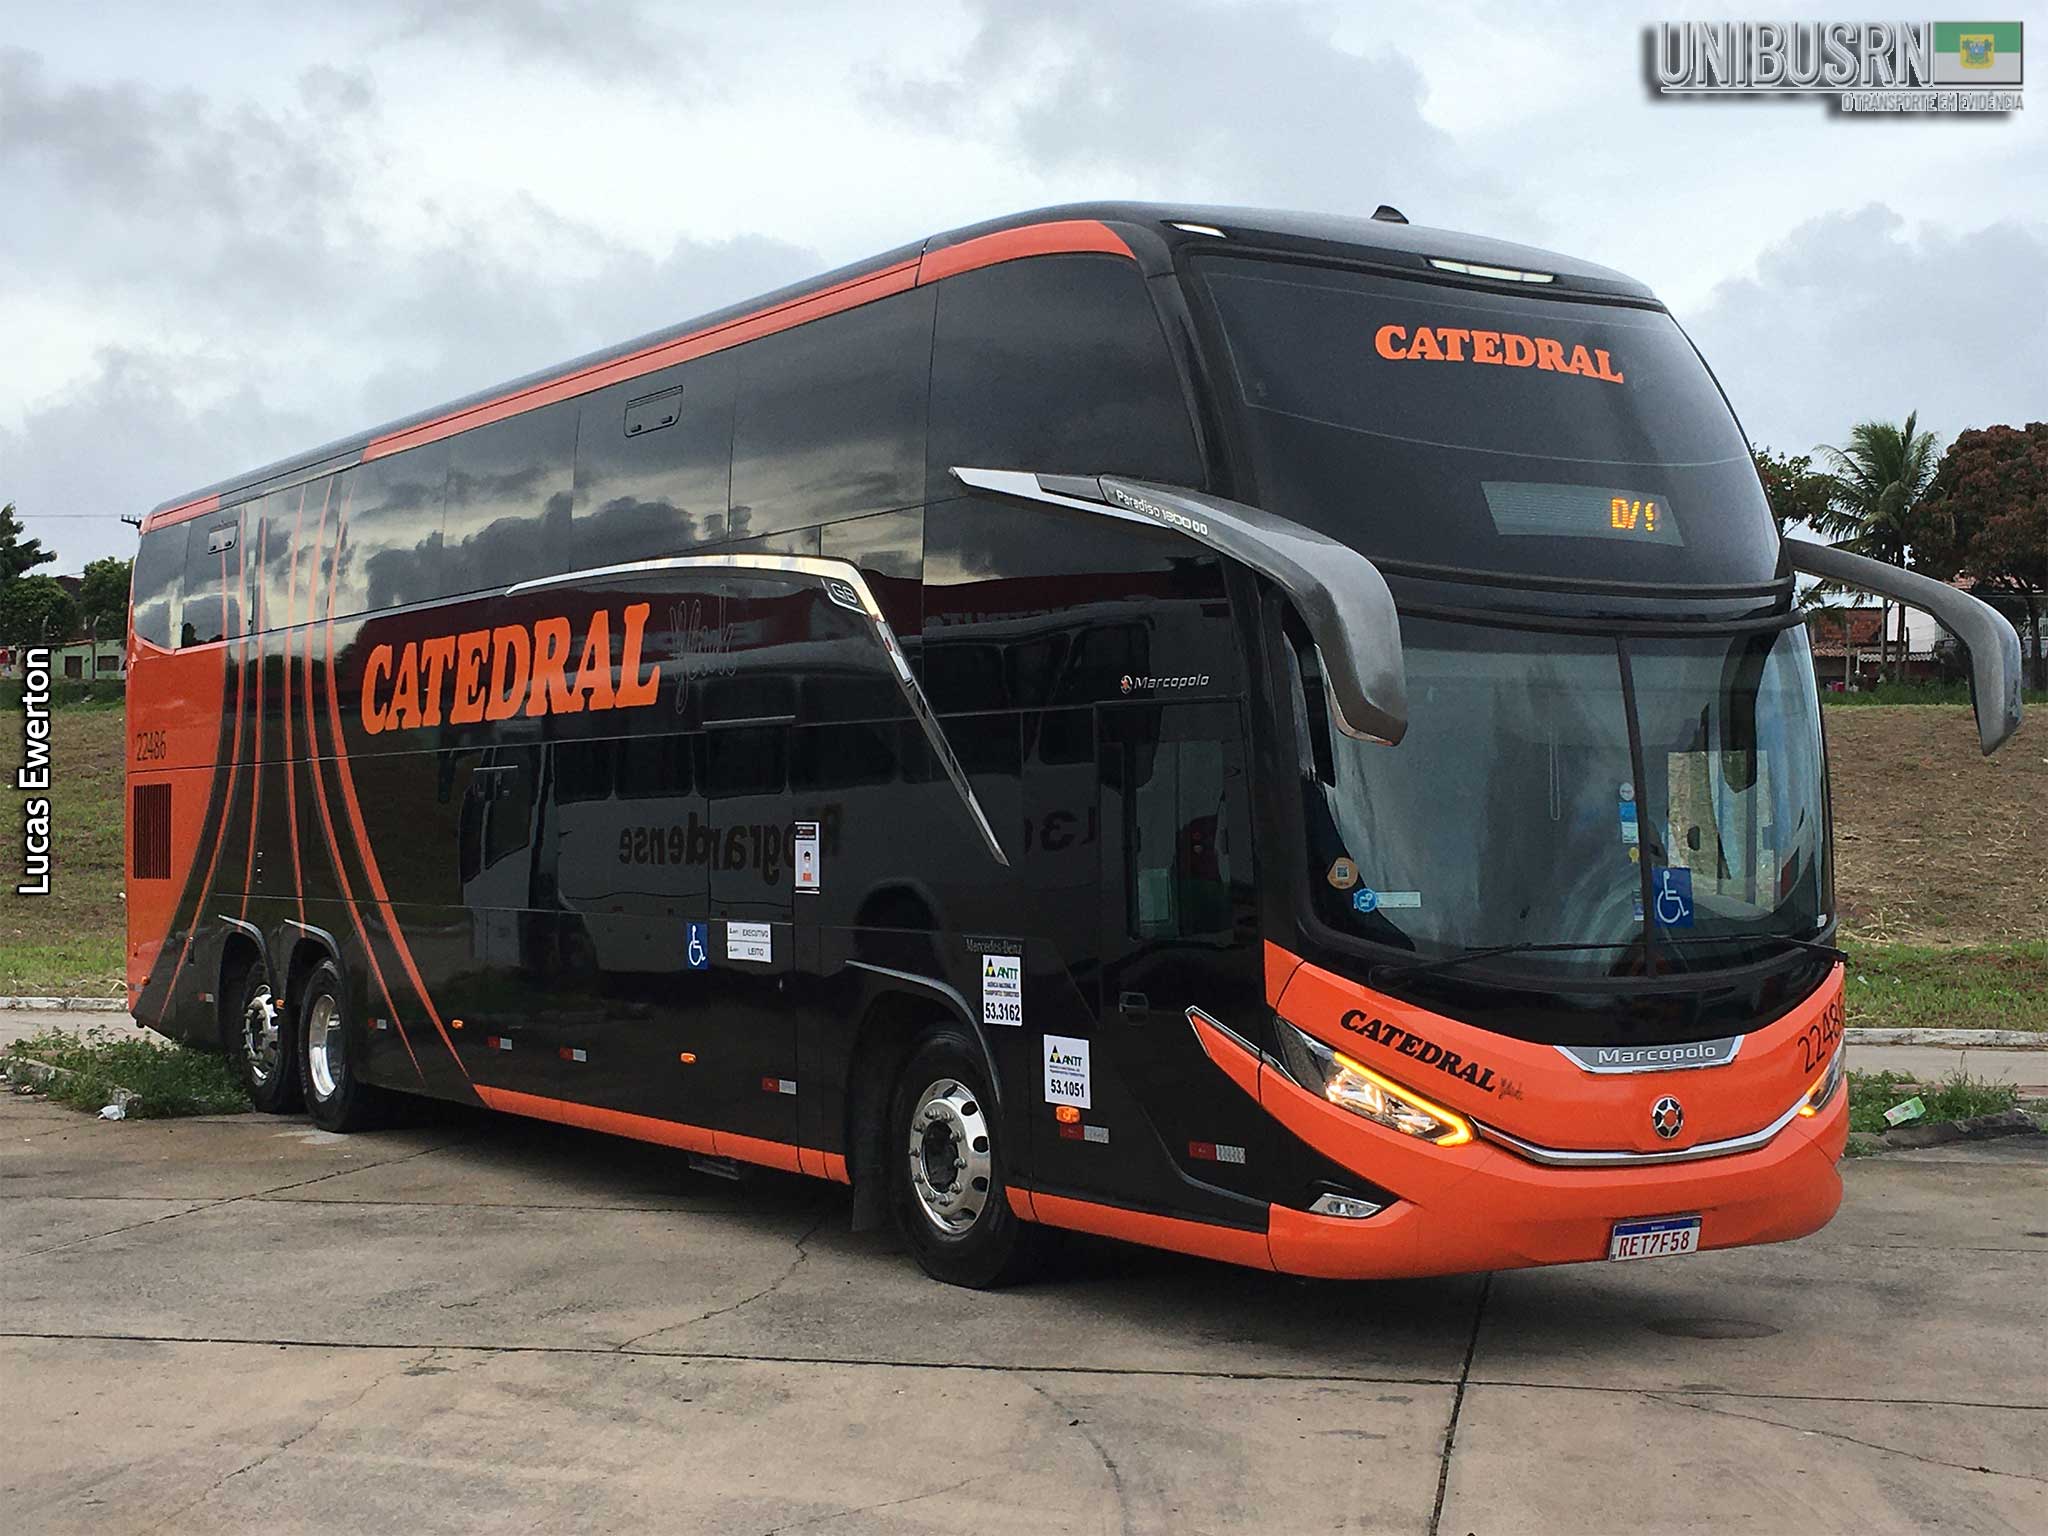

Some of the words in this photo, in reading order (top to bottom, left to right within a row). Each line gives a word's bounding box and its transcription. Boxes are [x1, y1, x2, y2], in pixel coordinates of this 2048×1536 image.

[1375, 325, 1624, 383] CATEDRAL
[1115, 489, 1160, 518] Paradiso
[361, 602, 661, 735] CATEDRAL
[1134, 673, 1209, 690] Marcopolo
[137, 730, 166, 761] 22486
[997, 966, 1018, 980] ANTT
[985, 1002, 1020, 1021] 53.3162
[1062, 1055, 1082, 1066] ANTT
[1340, 1009, 1496, 1092] CATEDRAL
[1598, 1044, 1716, 1064] Marcopolo
[1050, 1079, 1085, 1098] 53.1051
[1618, 1231, 1690, 1257] RET7F58
